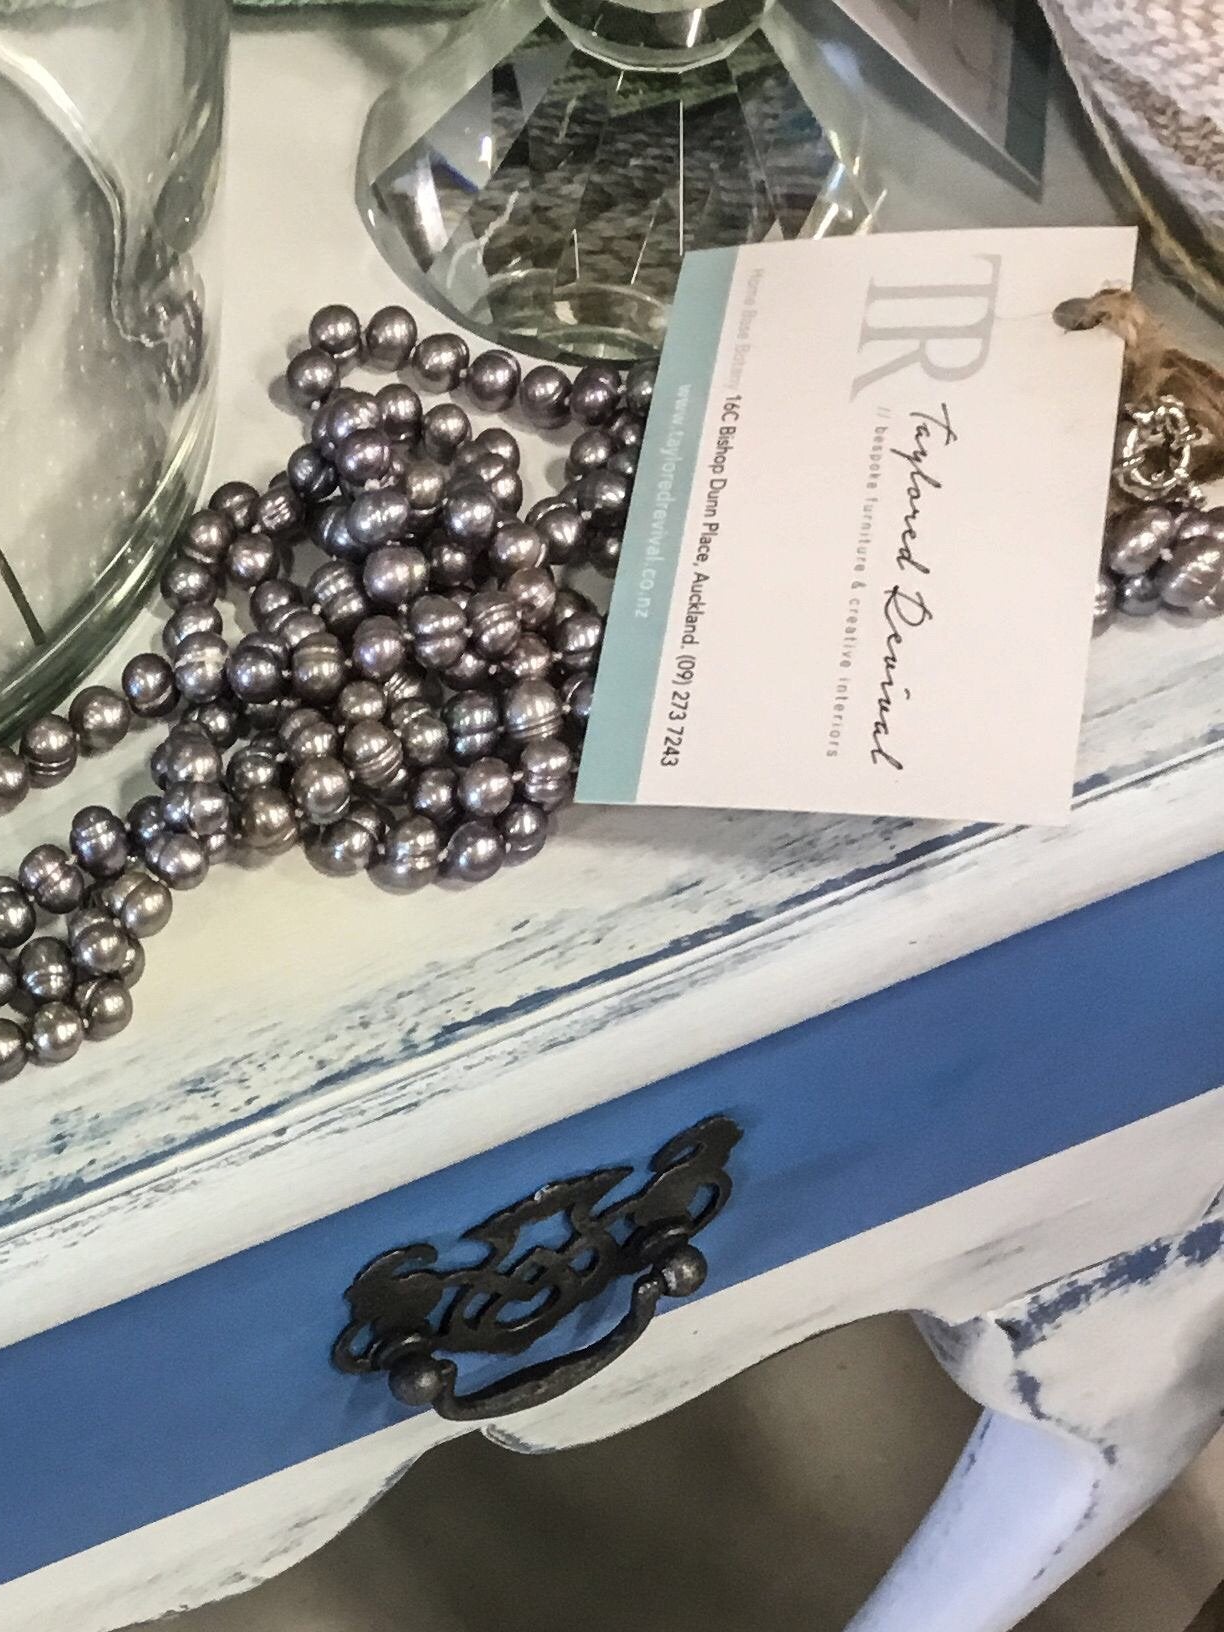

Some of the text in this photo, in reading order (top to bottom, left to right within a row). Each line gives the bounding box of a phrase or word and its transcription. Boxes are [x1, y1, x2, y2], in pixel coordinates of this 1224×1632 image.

[849, 253, 1002, 403] TR
[721, 395, 742, 422] 16C
[708, 426, 737, 474] Bishop
[866, 425, 888, 490] bespoke
[635, 384, 692, 618] www.tayloredrevival.co.nz
[704, 478, 728, 518] Dunn
[693, 522, 719, 567] Place,
[853, 497, 879, 572] furniture
[680, 571, 710, 649] Auckland.
[851, 580, 867, 590] &
[870, 402, 958, 770] Taylored Revival
[839, 598, 861, 669] creative
[672, 654, 696, 685] (09)
[668, 691, 690, 721] 273
[826, 677, 852, 758] interiors
[660, 726, 685, 767] 7243
